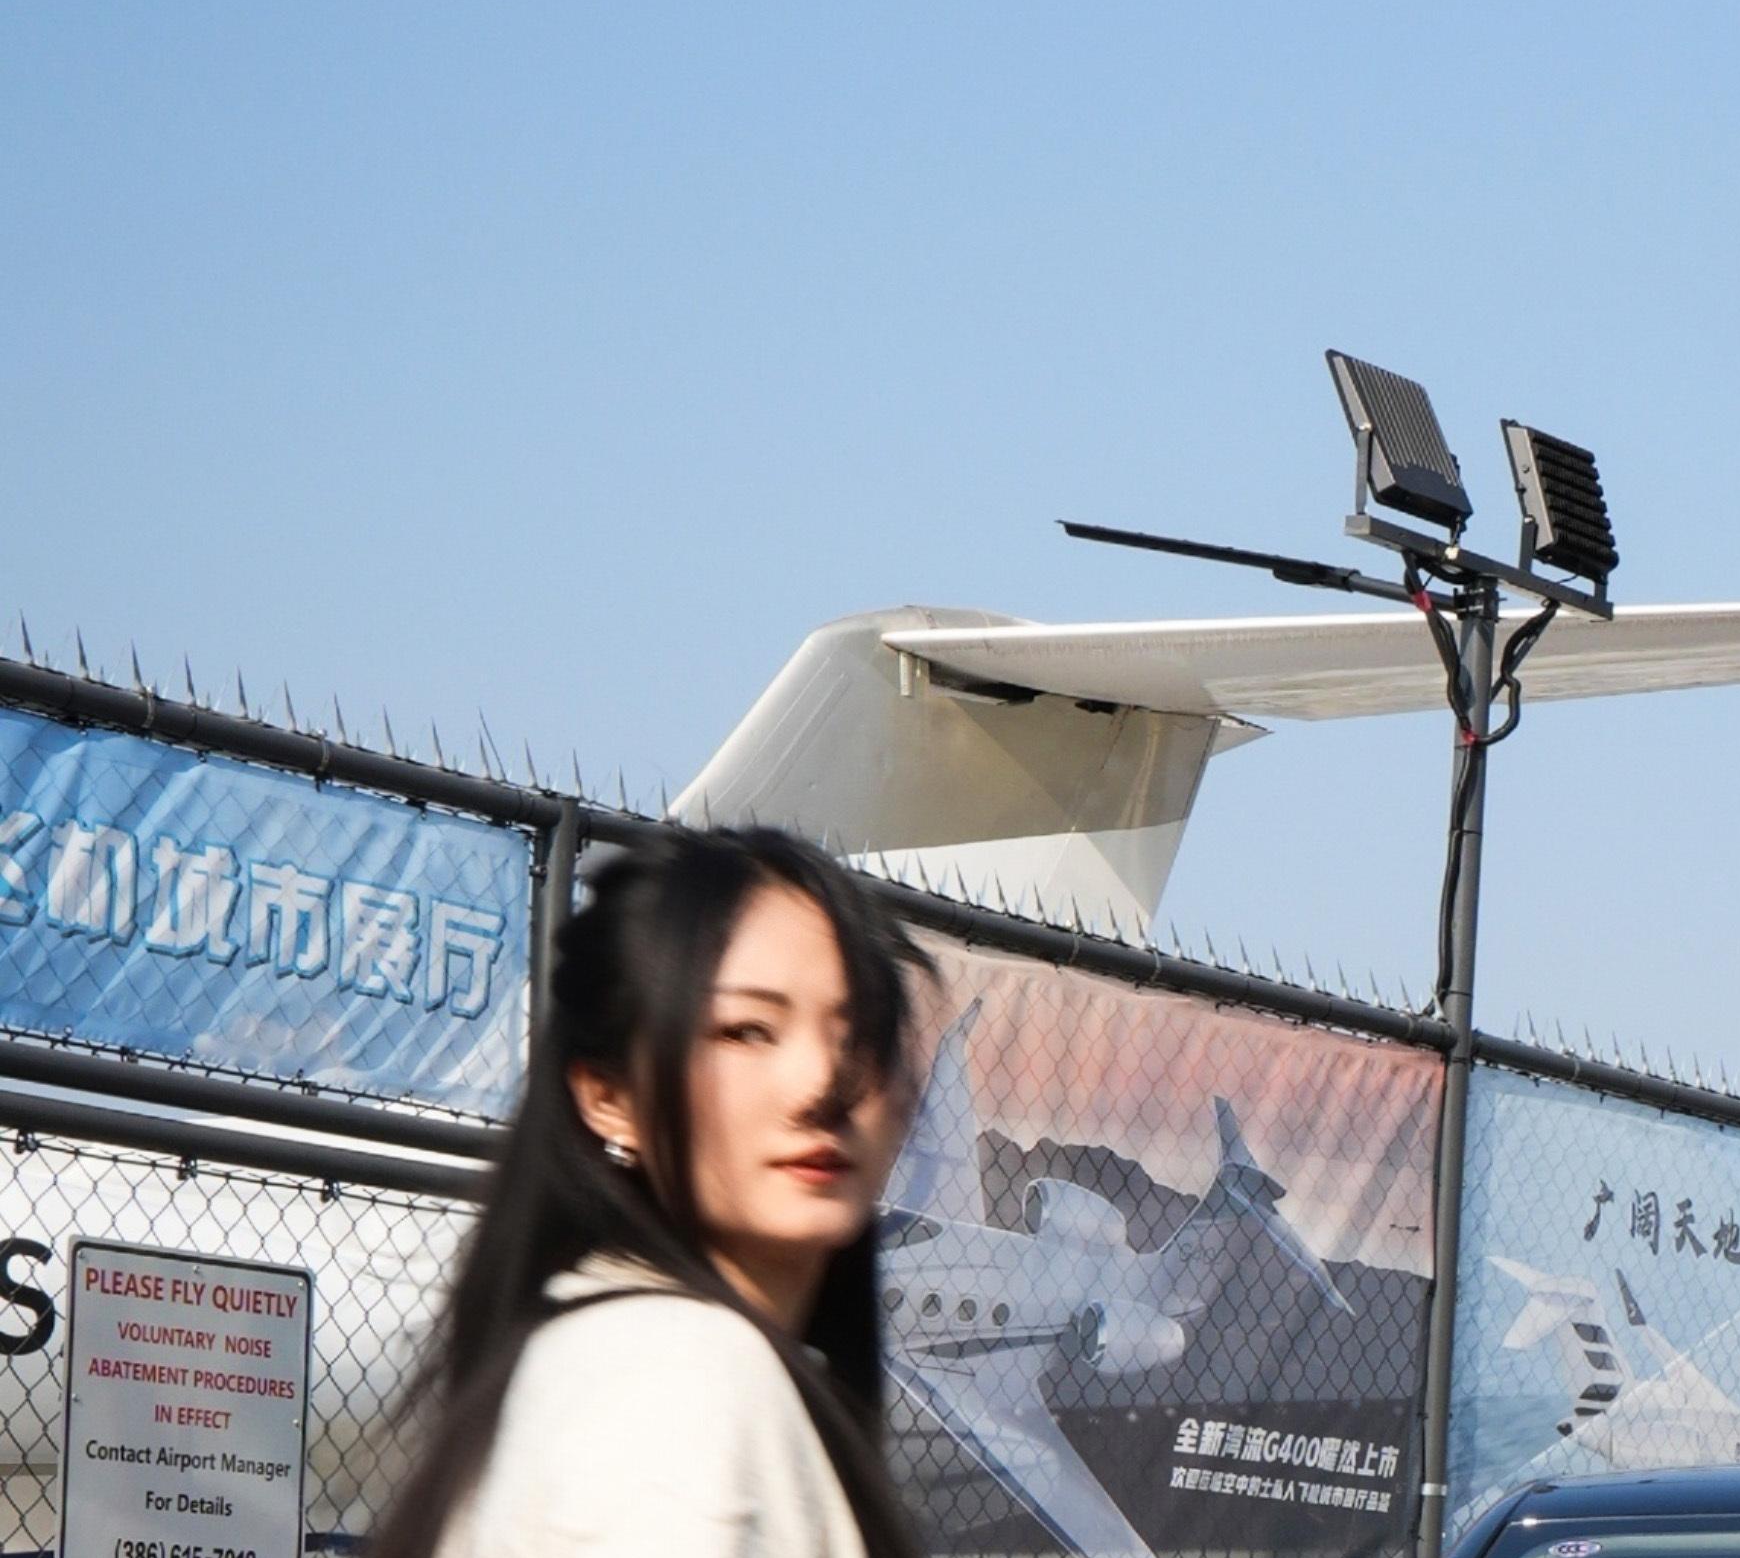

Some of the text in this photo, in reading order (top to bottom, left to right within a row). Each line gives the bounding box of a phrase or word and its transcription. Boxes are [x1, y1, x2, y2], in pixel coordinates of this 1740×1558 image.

[85, 1267, 298, 1318] PLEASE FLY QUIETLY
[118, 1322, 272, 1358] VOLUNTARY NOISE
[88, 1358, 295, 1399] ABATEMENT PROCEDURES
[154, 1405, 232, 1429] IN EFFECT
[86, 1439, 292, 1481] Contact Airport Manager
[145, 1491, 233, 1517] For Details
